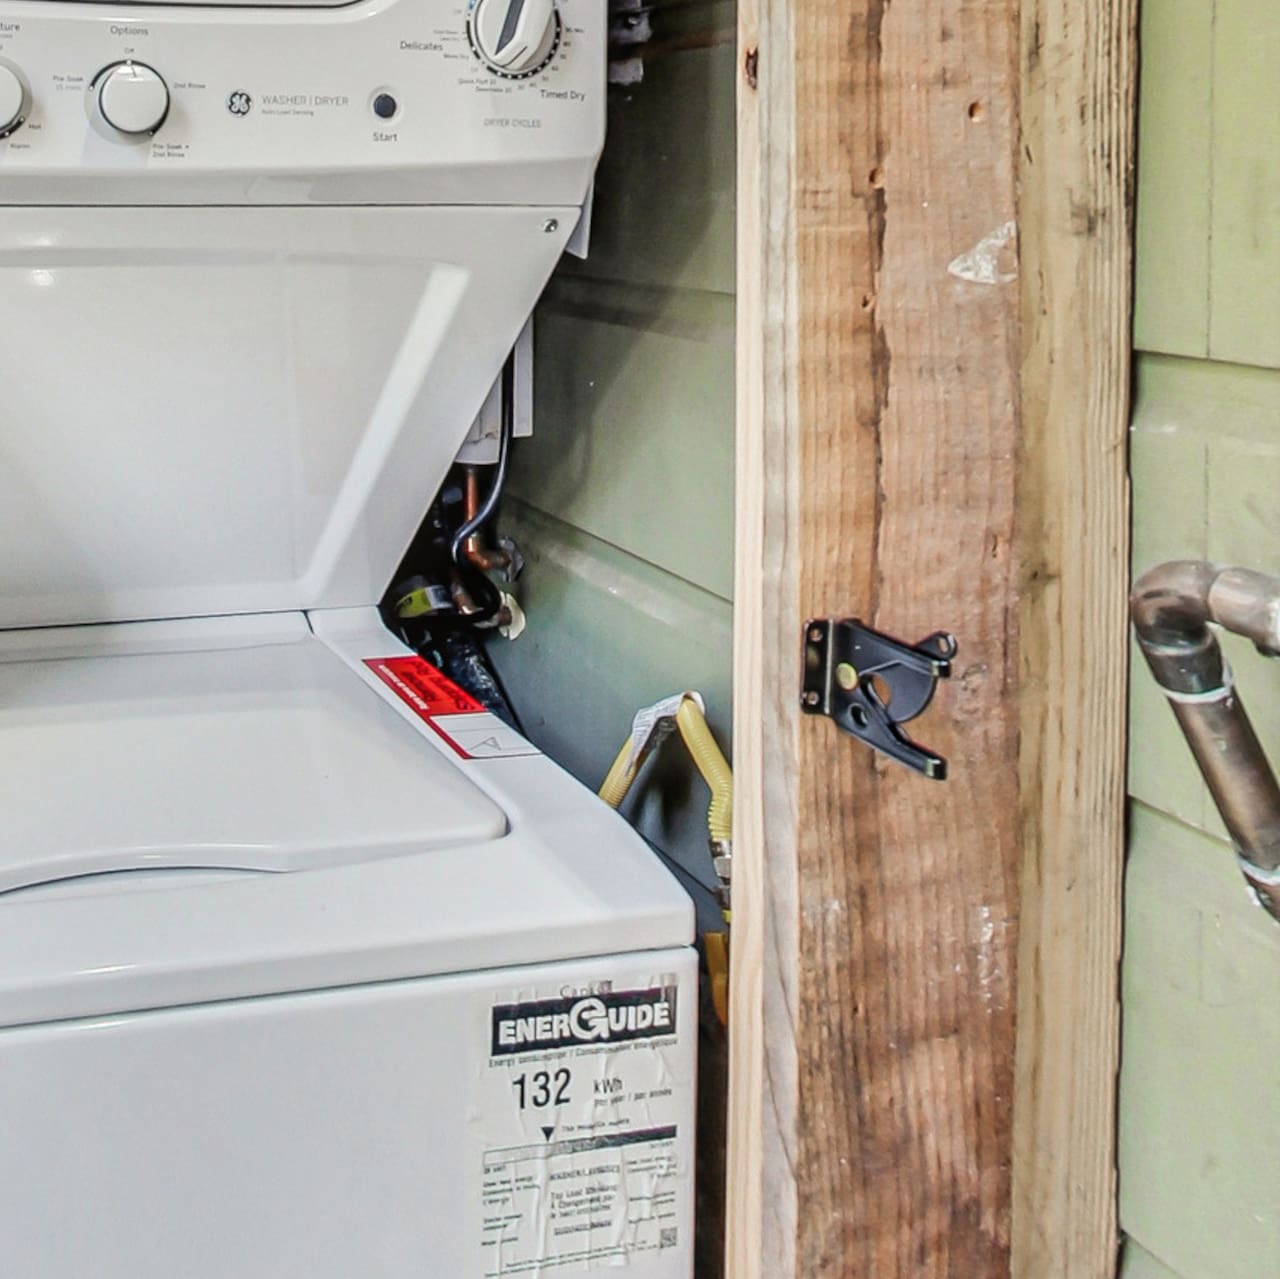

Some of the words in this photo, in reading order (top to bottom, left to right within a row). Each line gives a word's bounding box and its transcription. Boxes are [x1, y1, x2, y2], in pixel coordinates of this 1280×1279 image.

[110, 26, 149, 36] Options
[400, 41, 443, 51] Delicates
[261, 95, 307, 105] WASHER
[315, 96, 349, 106] DRYER
[540, 90, 569, 99] Timed
[570, 90, 586, 101] Dry
[373, 132, 398, 142] Start
[499, 997, 670, 1045] ENERGUIDE
[512, 1068, 571, 1109] 132
[593, 1077, 622, 1094] kWh
